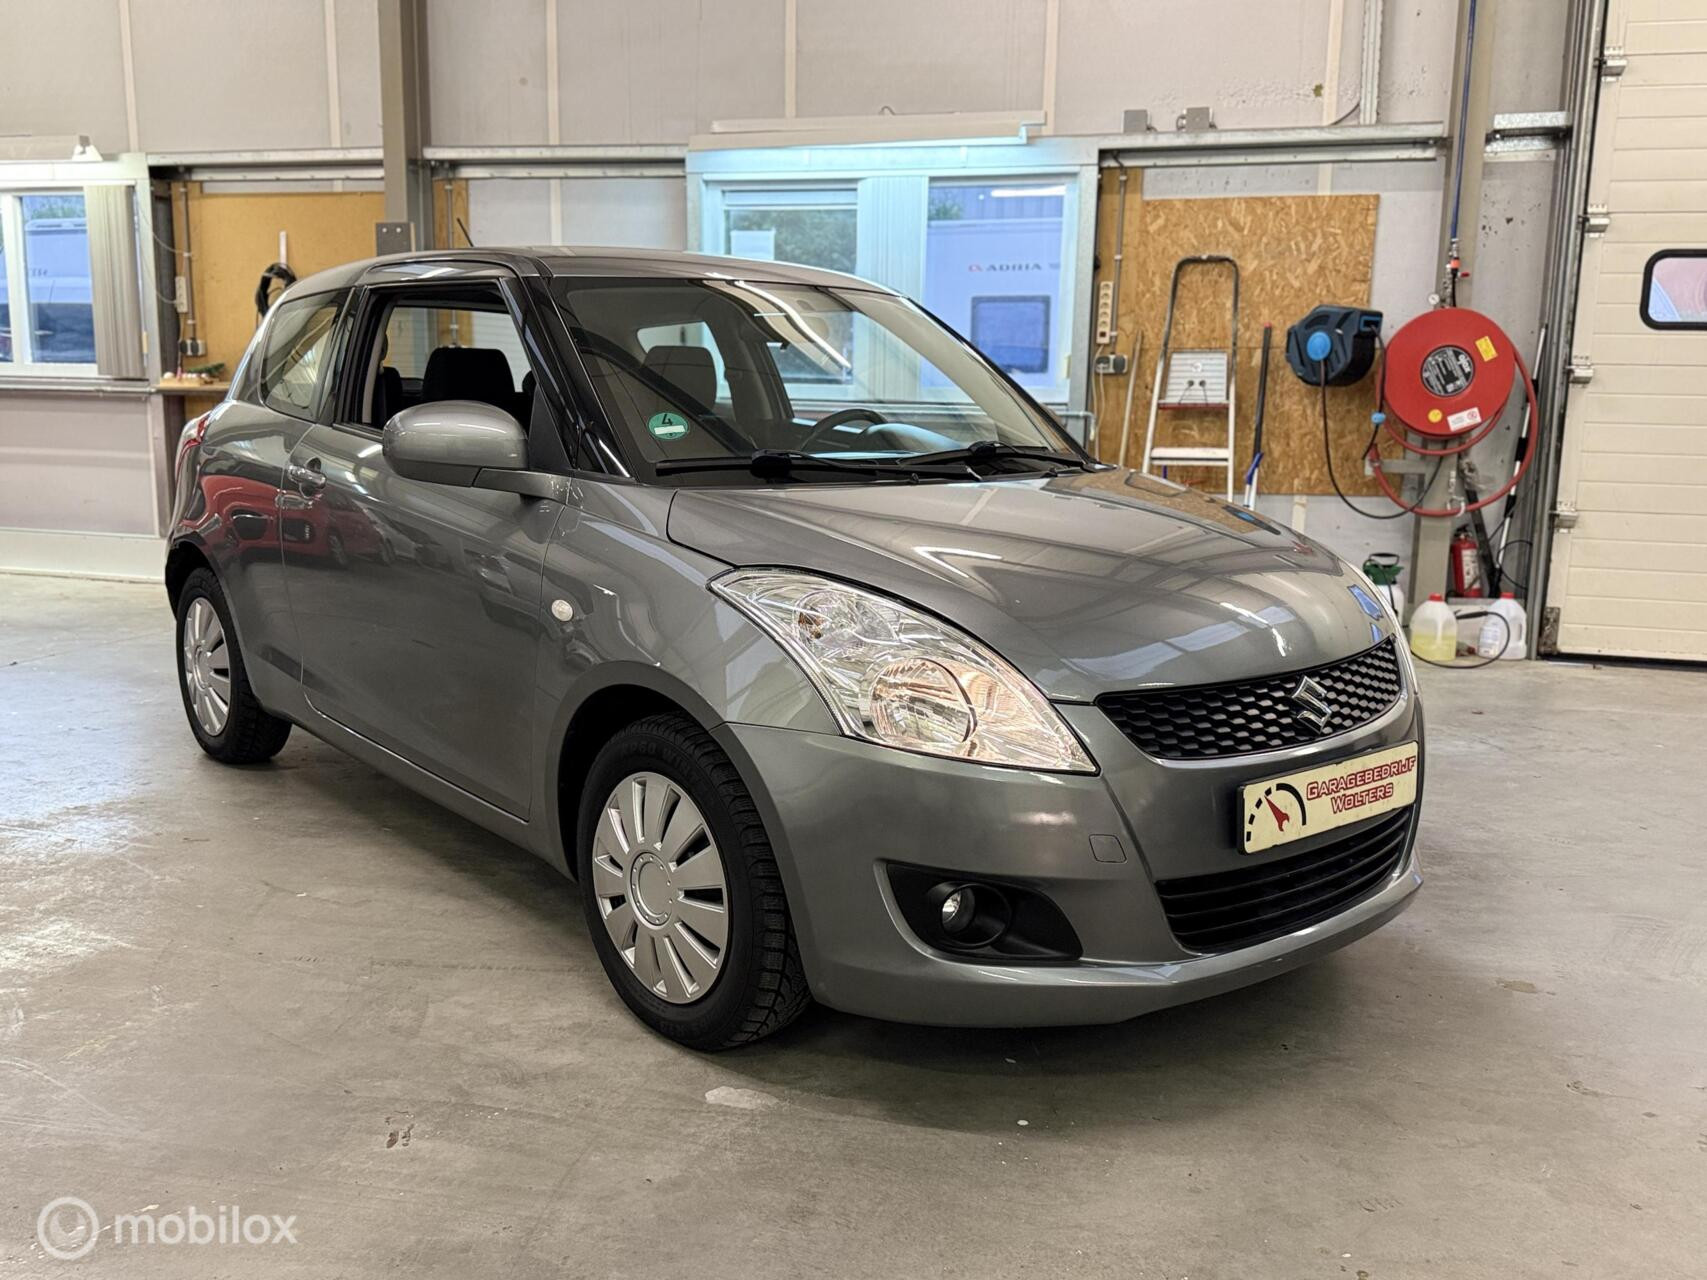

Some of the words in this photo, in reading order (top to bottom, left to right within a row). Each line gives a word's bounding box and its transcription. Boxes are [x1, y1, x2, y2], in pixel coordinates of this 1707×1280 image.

[662, 413, 673, 426] 4
[1306, 755, 1416, 801] GARAGEBEDRIJF
[1331, 783, 1394, 814] WOLTERS
